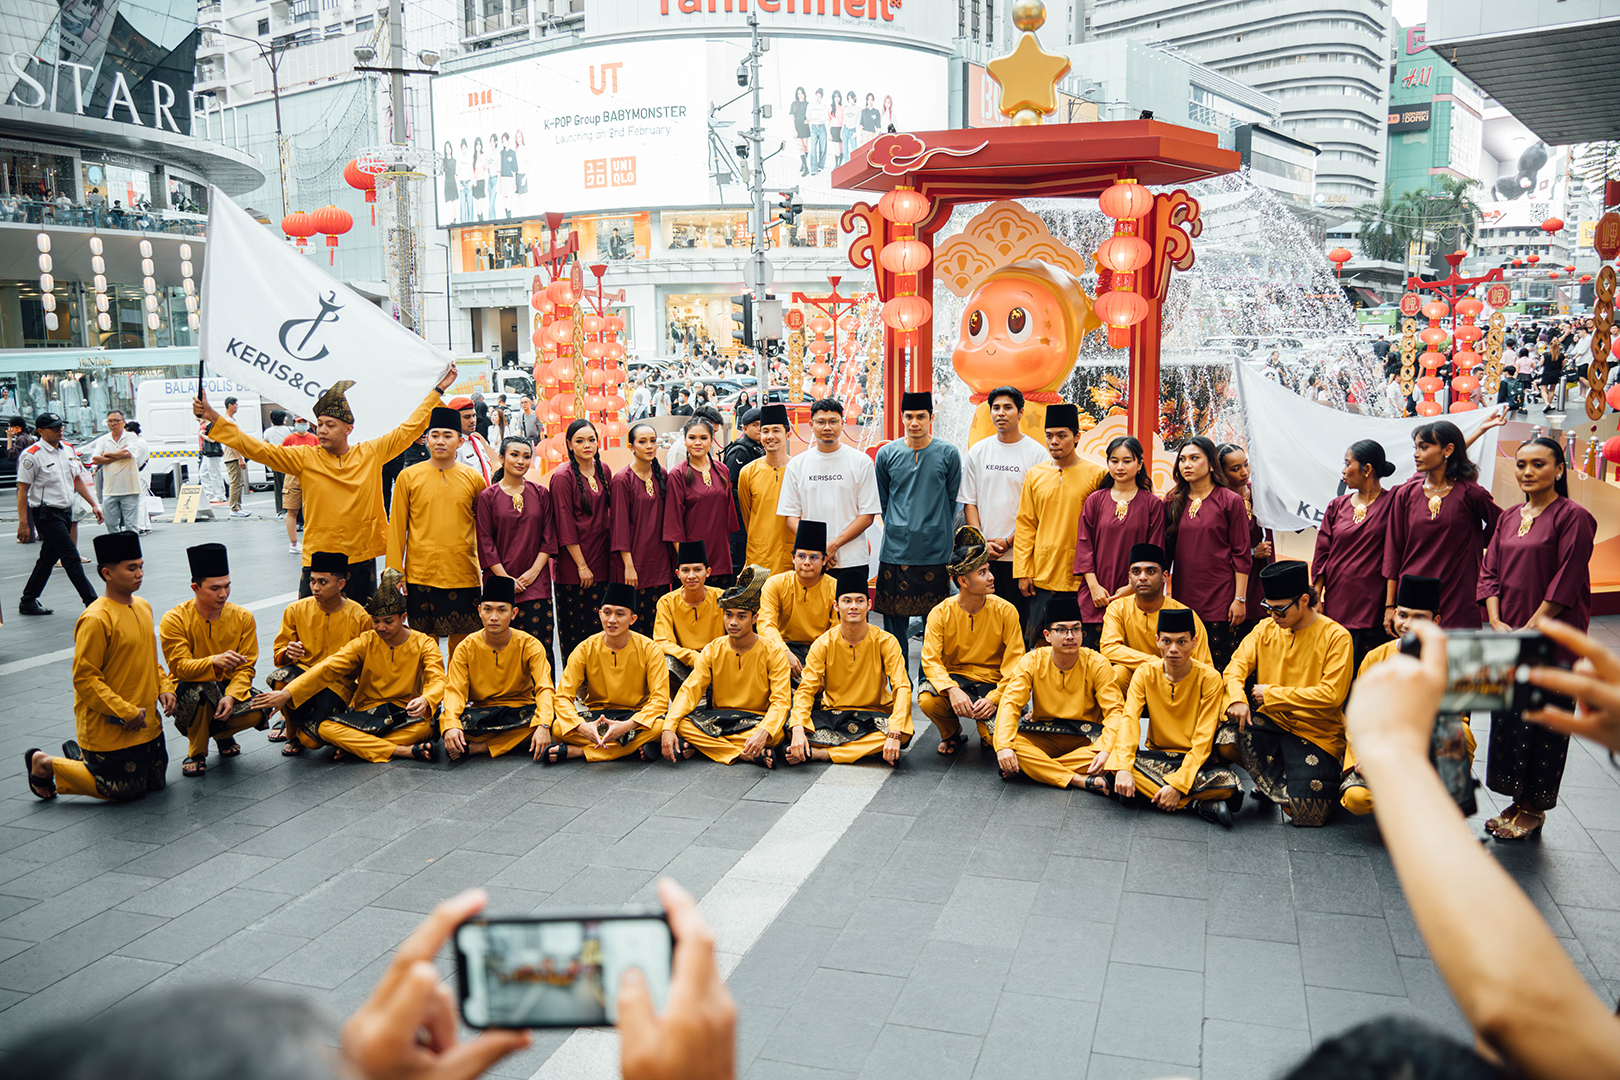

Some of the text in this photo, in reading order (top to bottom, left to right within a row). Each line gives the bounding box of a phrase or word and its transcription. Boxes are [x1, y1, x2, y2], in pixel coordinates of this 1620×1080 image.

[589, 62, 623, 96] UT
[1402, 66, 1433, 88] H&M
[544, 105, 687, 130] K-POP Group BABYMONSTER
[555, 125, 672, 145] Launching on 2nd February
